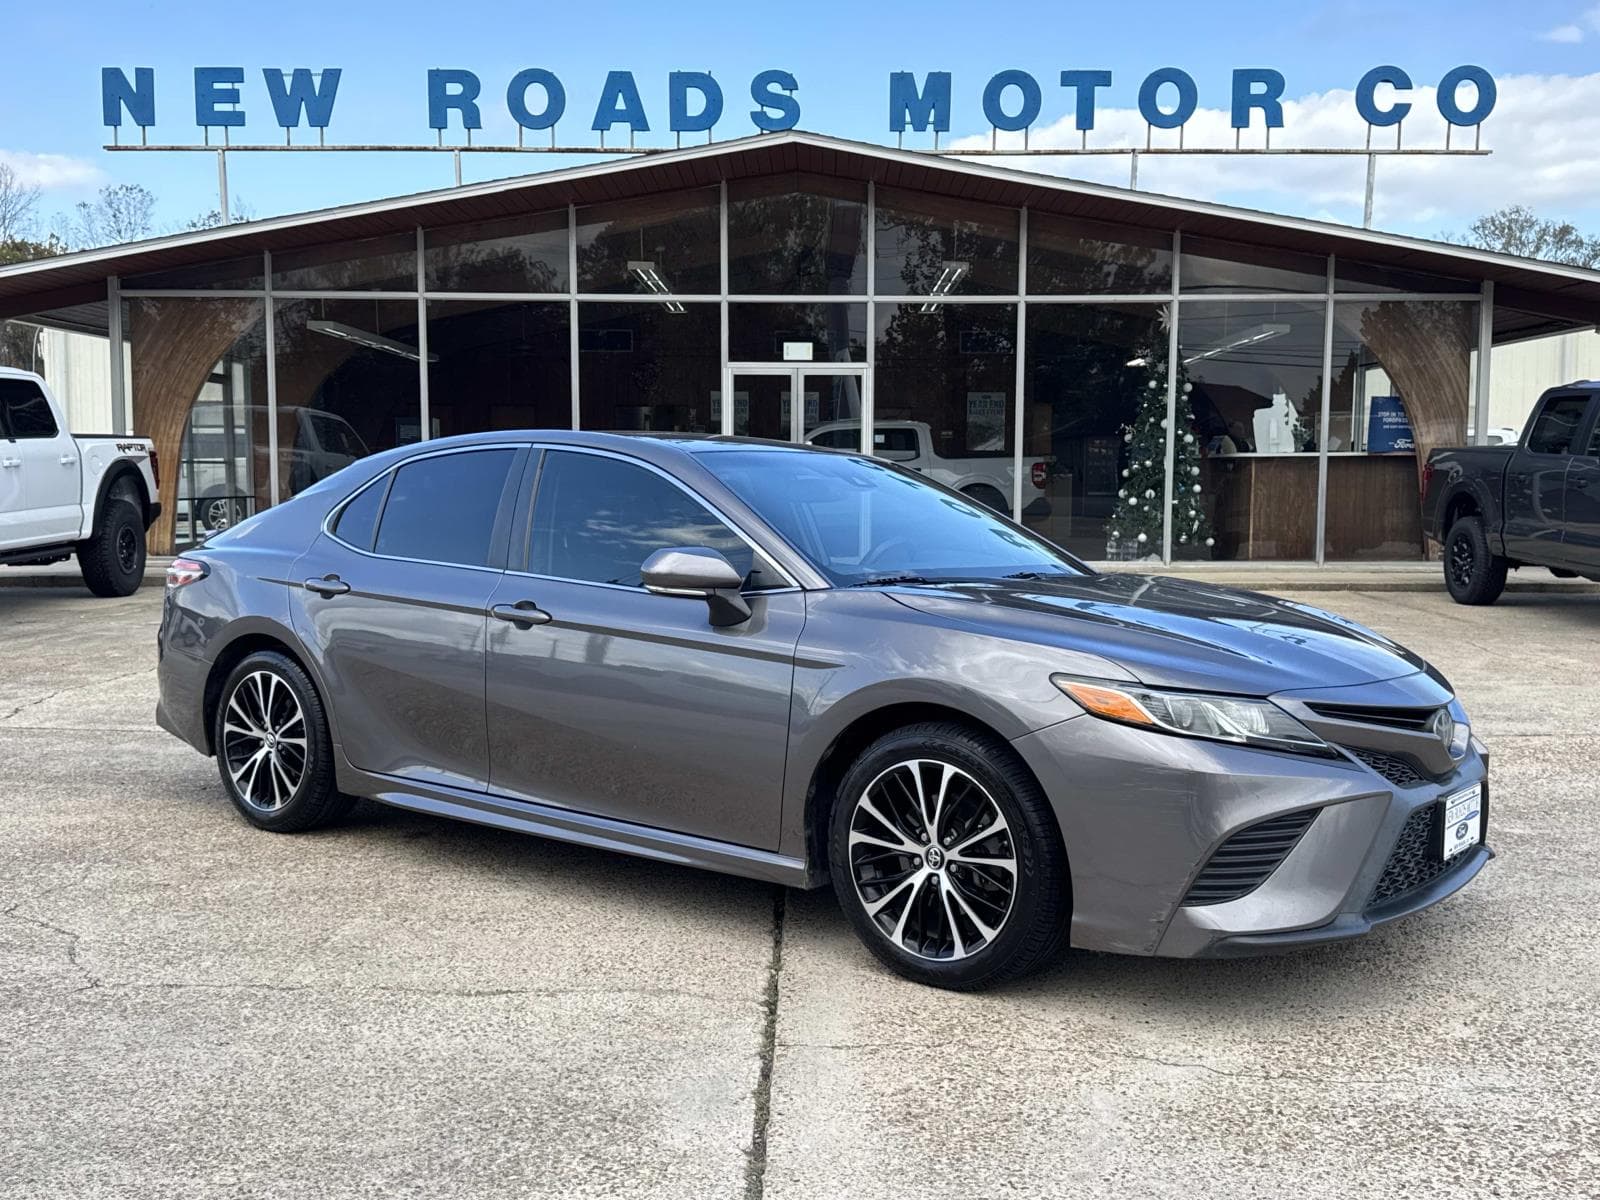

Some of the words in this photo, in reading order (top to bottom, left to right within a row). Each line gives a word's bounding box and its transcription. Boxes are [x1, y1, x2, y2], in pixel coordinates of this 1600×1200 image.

[102, 68, 342, 128] NEW
[428, 69, 800, 133] ROADS
[890, 68, 1285, 132] MOTOR
[1356, 65, 1496, 127] CO
[116, 444, 147, 454] RAPTOR
